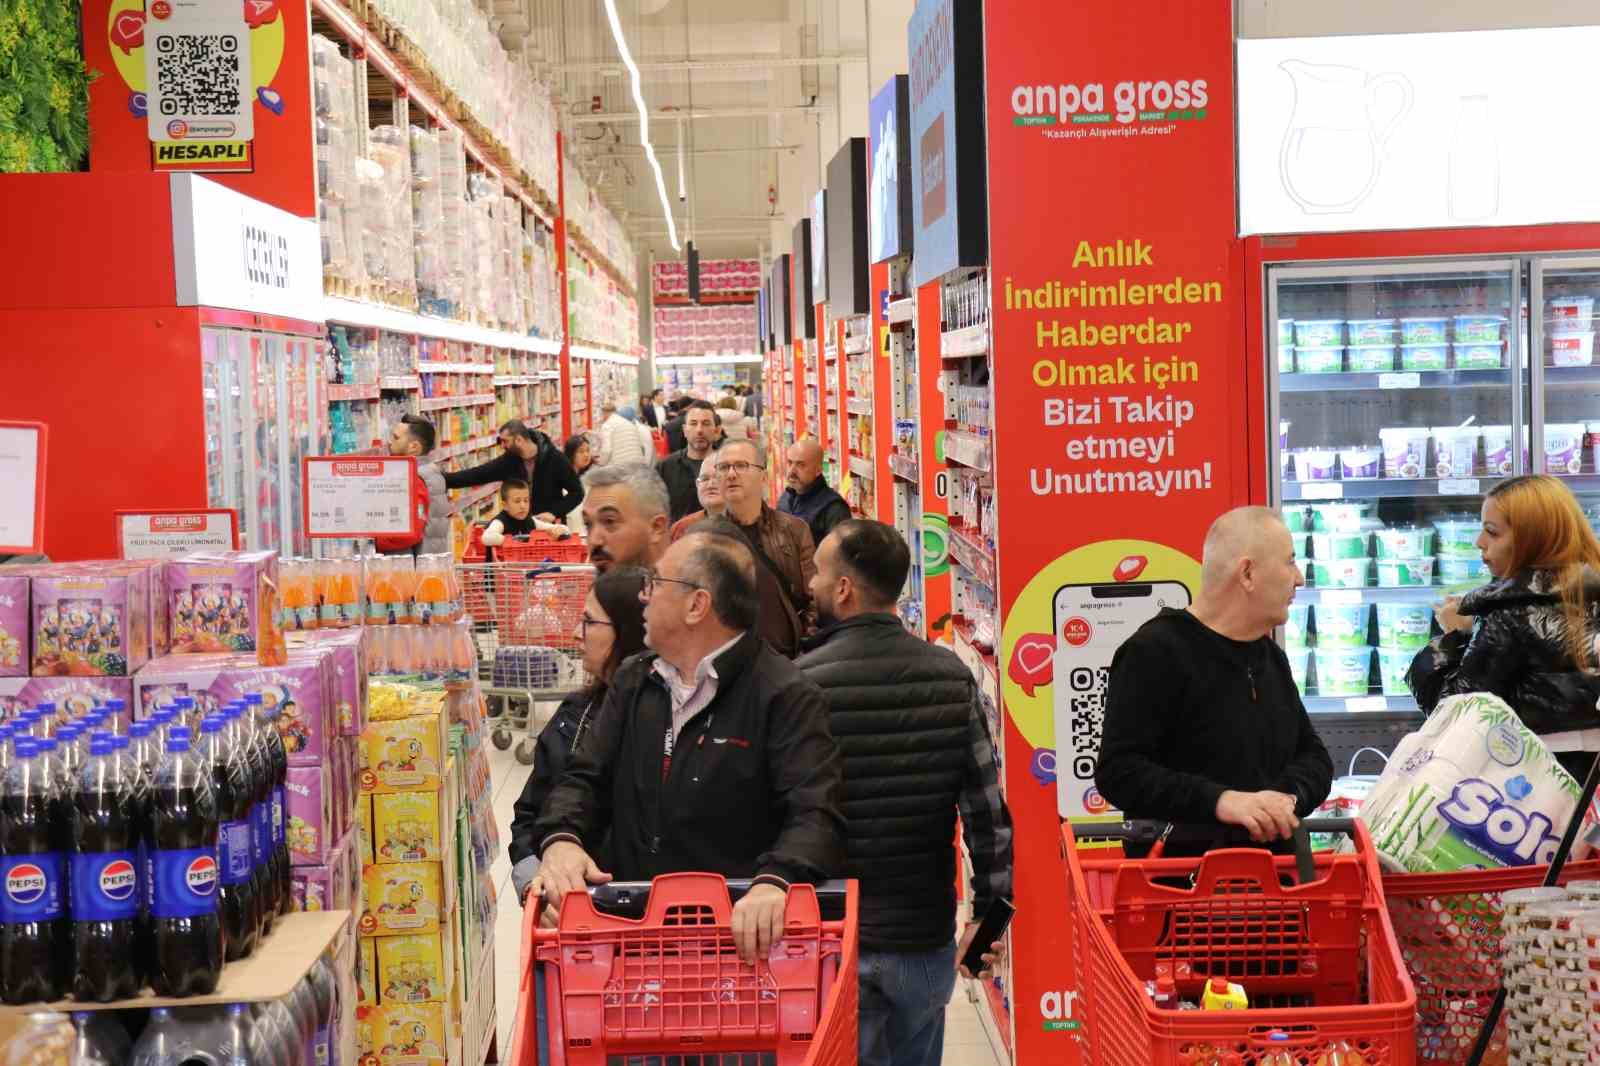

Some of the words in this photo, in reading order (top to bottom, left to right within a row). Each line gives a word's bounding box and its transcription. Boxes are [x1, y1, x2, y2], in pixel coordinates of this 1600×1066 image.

[1011, 83, 1104, 125] anpa
[1113, 79, 1208, 124] gross
[159, 144, 244, 159] HESAPLI
[1071, 239, 1153, 268] Anlık
[1004, 276, 1222, 310] İndirimlerden
[1036, 317, 1192, 348] Haberdar
[1032, 357, 1136, 387] Olmak
[1143, 355, 1199, 389] için
[1044, 397, 1101, 426] Bizi
[1108, 394, 1194, 428] Takip
[1066, 430, 1175, 463] etmeyi
[1030, 462, 1213, 497] Unutmayın!
[8, 877, 44, 888] PEPSI
[189, 870, 215, 881] PEPS
